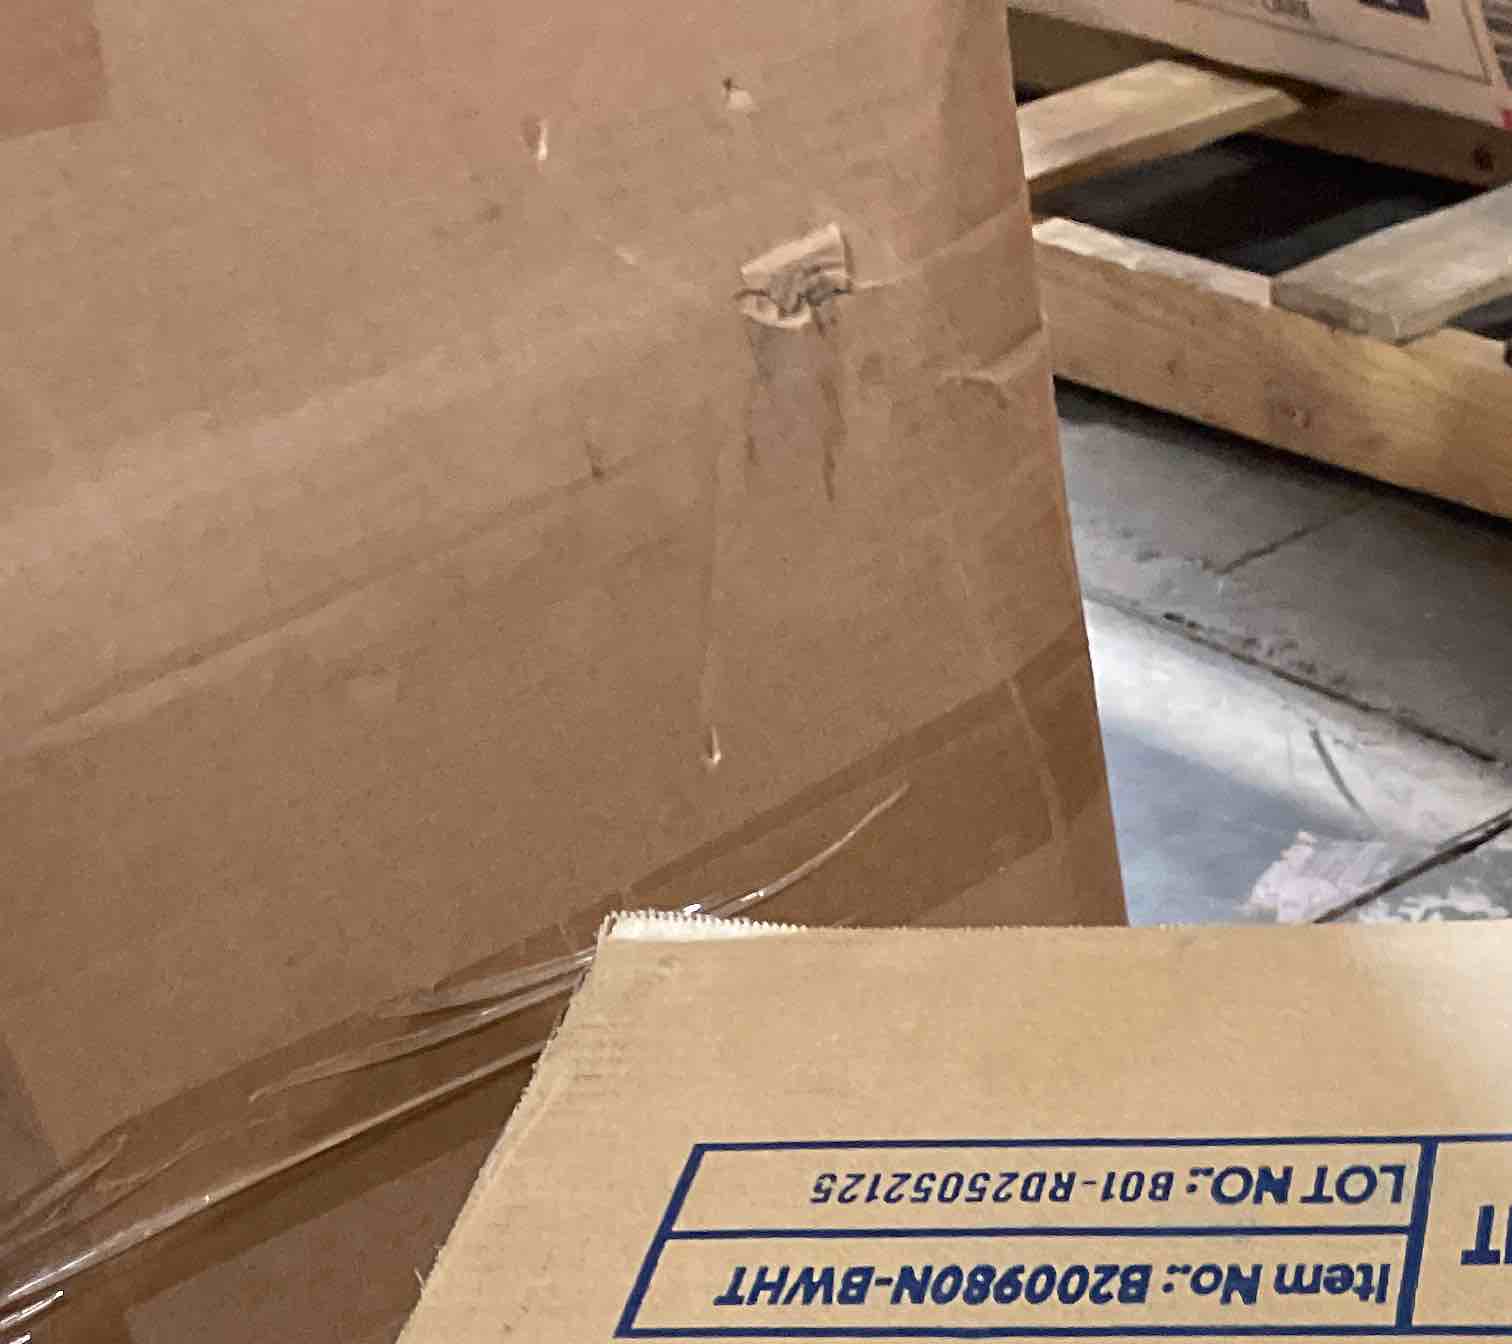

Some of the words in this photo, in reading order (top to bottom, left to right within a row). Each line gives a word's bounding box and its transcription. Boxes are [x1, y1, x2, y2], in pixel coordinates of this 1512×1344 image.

[809, 1170, 1175, 1204] B01-RD25052125
[1300, 1164, 1406, 1205] LOT
[713, 1263, 1153, 1307] B200980N-BWHT
[1273, 1263, 1391, 1305] Item
